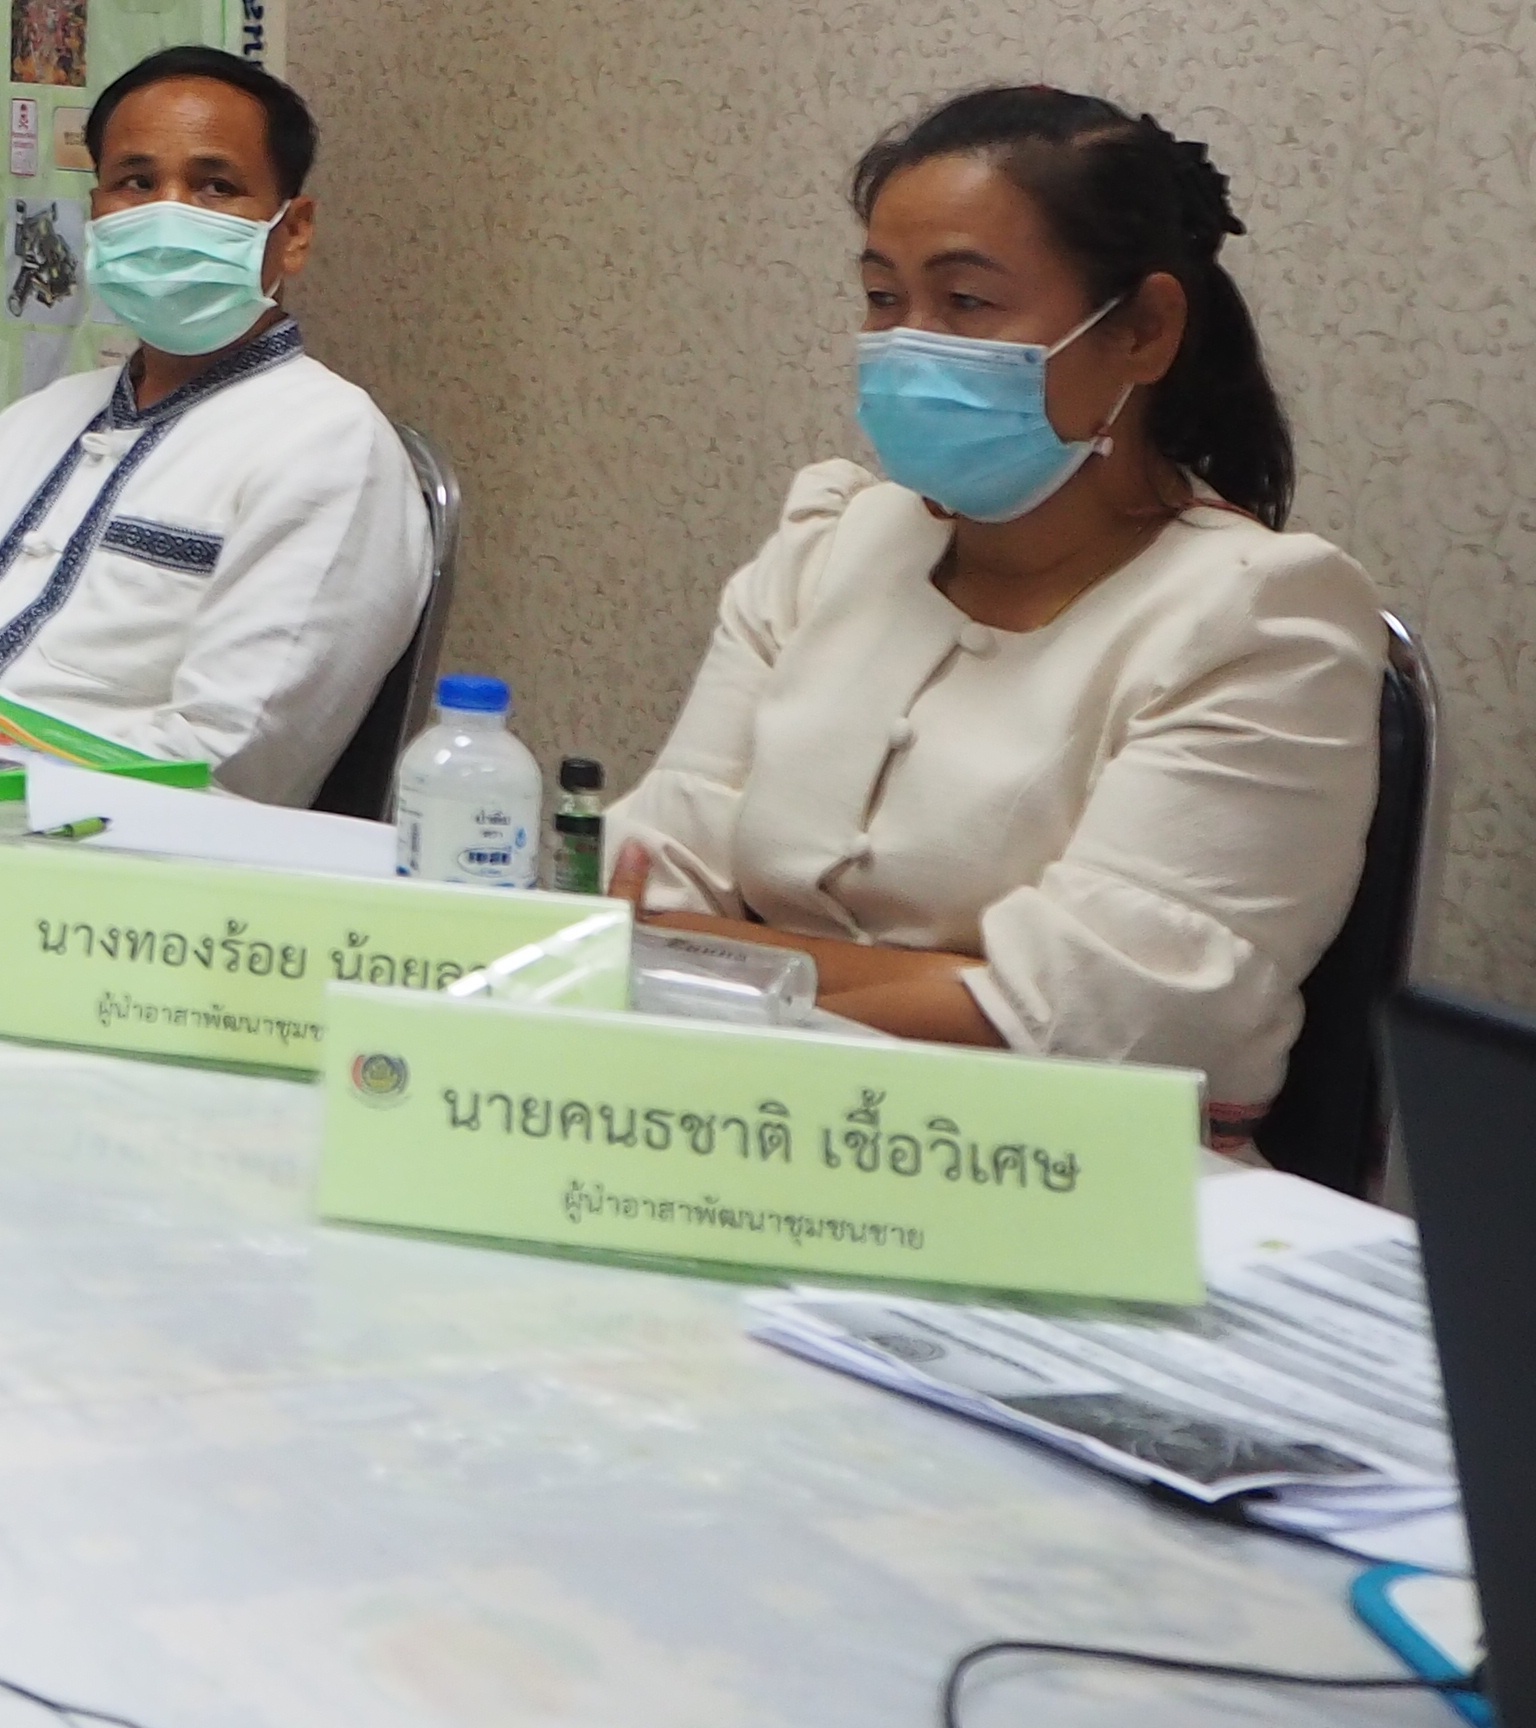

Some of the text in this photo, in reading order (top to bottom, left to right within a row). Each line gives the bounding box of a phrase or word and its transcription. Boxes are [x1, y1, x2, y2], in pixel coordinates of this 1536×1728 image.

[37, 917, 308, 981] นางทองร้อย
[96, 991, 328, 1045] ผู้นำอาสาพัฒนาชุมช
[442, 1083, 1083, 1194] นายคนธชาติ เชื้อวิเศษ
[562, 1182, 927, 1251] ผู้นำอาสาพัฒนาชุมชนชาย
